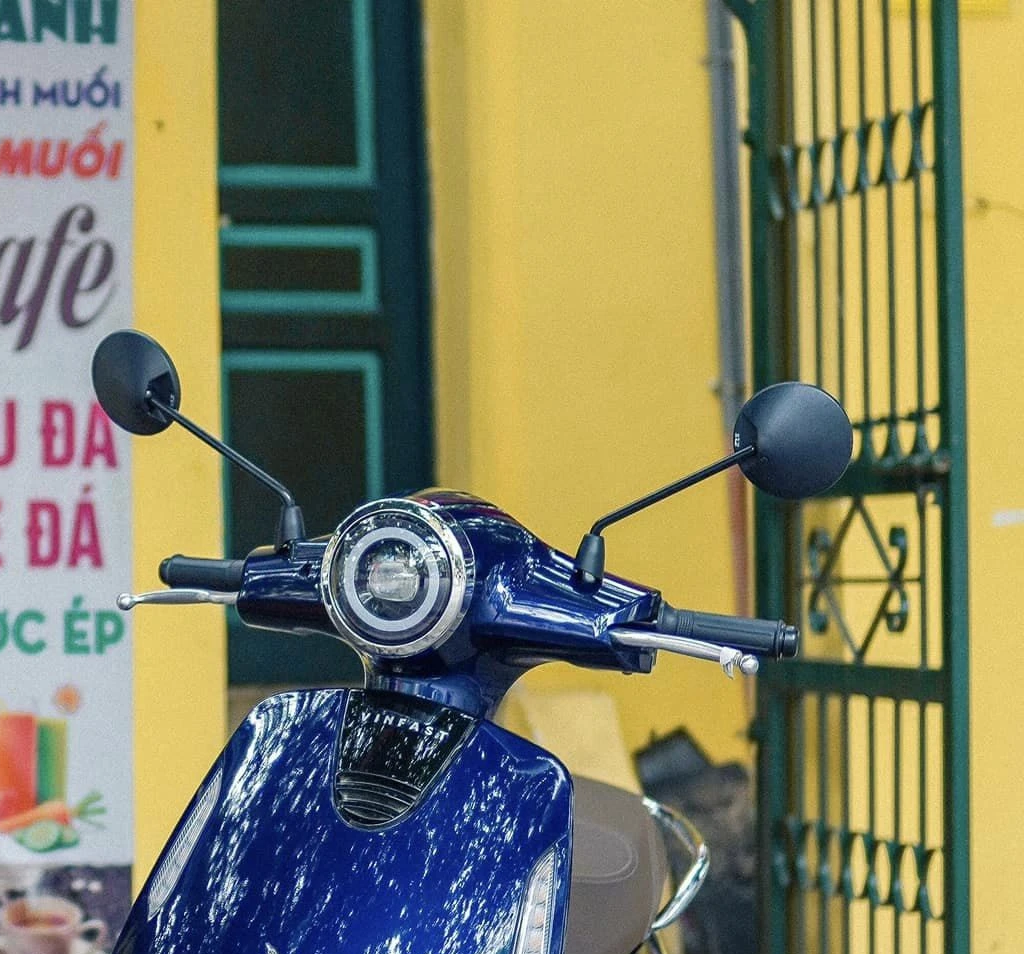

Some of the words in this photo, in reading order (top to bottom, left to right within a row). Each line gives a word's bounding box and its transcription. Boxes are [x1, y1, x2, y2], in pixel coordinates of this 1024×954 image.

[33, 64, 123, 108] MUỐI
[25, 483, 105, 569] ĐÁ
[62, 595, 126, 655] ÉP
[360, 711, 450, 742] VINFAST
